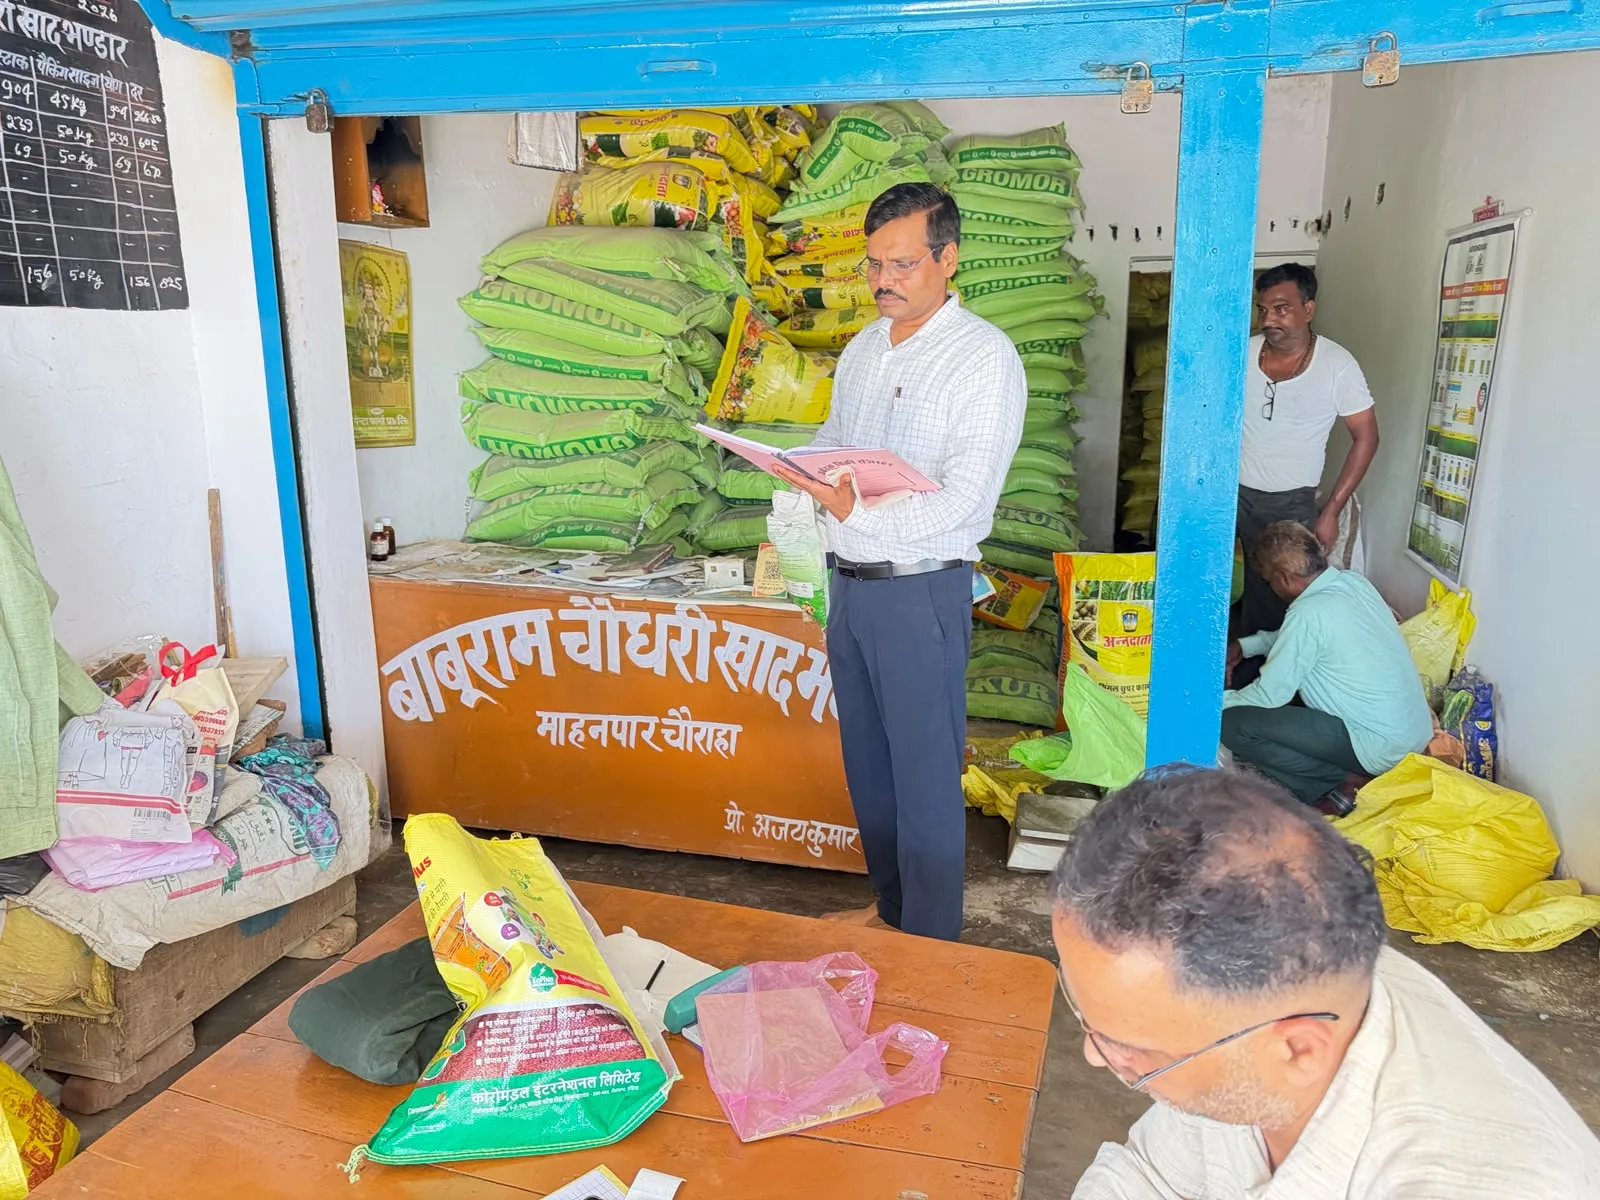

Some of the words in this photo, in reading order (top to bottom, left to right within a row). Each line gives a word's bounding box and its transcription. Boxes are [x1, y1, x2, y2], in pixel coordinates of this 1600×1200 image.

[17, 5, 67, 55] खाद
[62, 20, 129, 68] भण्डार
[6, 115, 33, 132] 239
[110, 131, 129, 146] 239
[962, 168, 1067, 195] GROMOR
[28, 263, 53, 284] 156
[129, 276, 151, 288] 156
[1104, 635, 1153, 649] अन्नदाता
[380, 608, 557, 722] बाबूराम
[558, 596, 718, 685] चौधरी
[714, 619, 805, 717] खाद
[966, 677, 1049, 702] KUR
[536, 711, 664, 752] माहनपार
[661, 705, 744, 760] चौराहा
[599, 1068, 642, 1088] लिमिटेड
